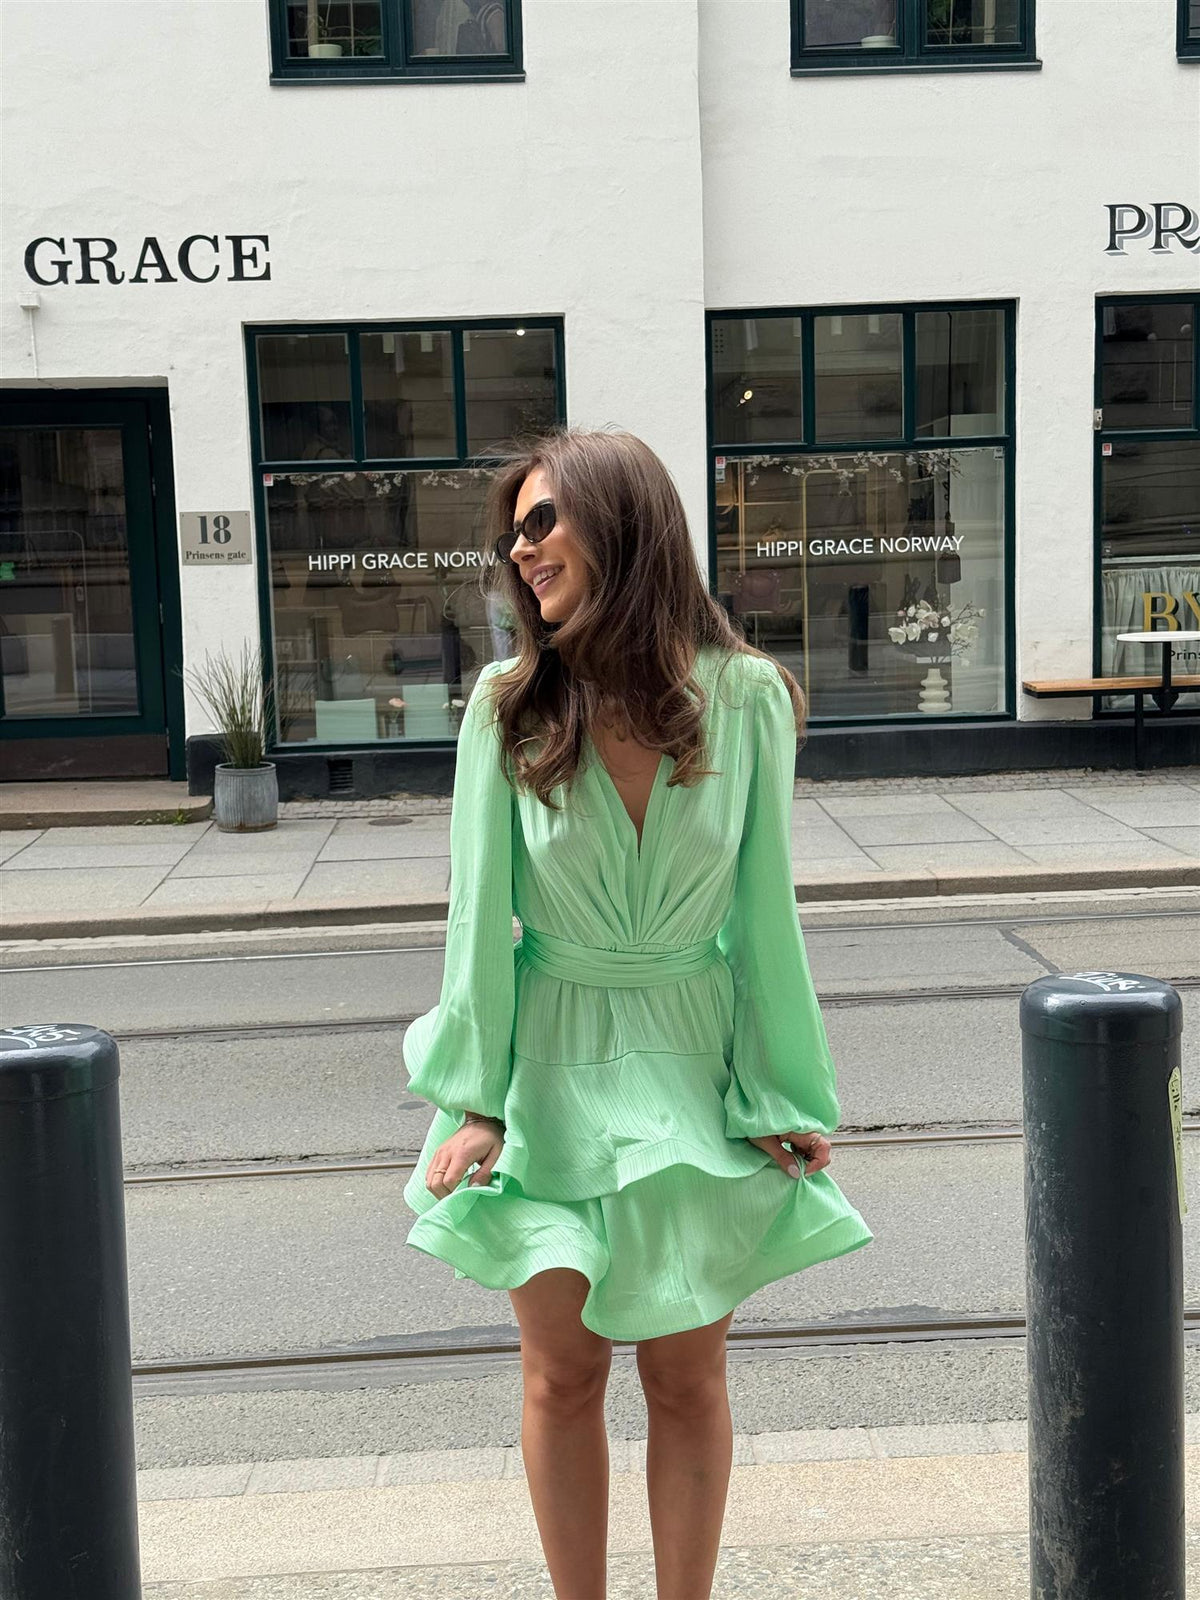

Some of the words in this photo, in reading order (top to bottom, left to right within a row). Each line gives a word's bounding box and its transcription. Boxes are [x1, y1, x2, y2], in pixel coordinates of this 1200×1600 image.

[24, 234, 271, 286] GRACE
[197, 514, 231, 545] 18
[185, 550, 225, 560] Prinsens
[227, 550, 247, 561] gate
[756, 540, 803, 557] HIPPI
[809, 538, 874, 556] GRACE
[880, 535, 965, 554] NORWAY
[308, 554, 356, 571] HIPPI
[362, 552, 429, 570] GRACE
[434, 551, 497, 569] NORW
